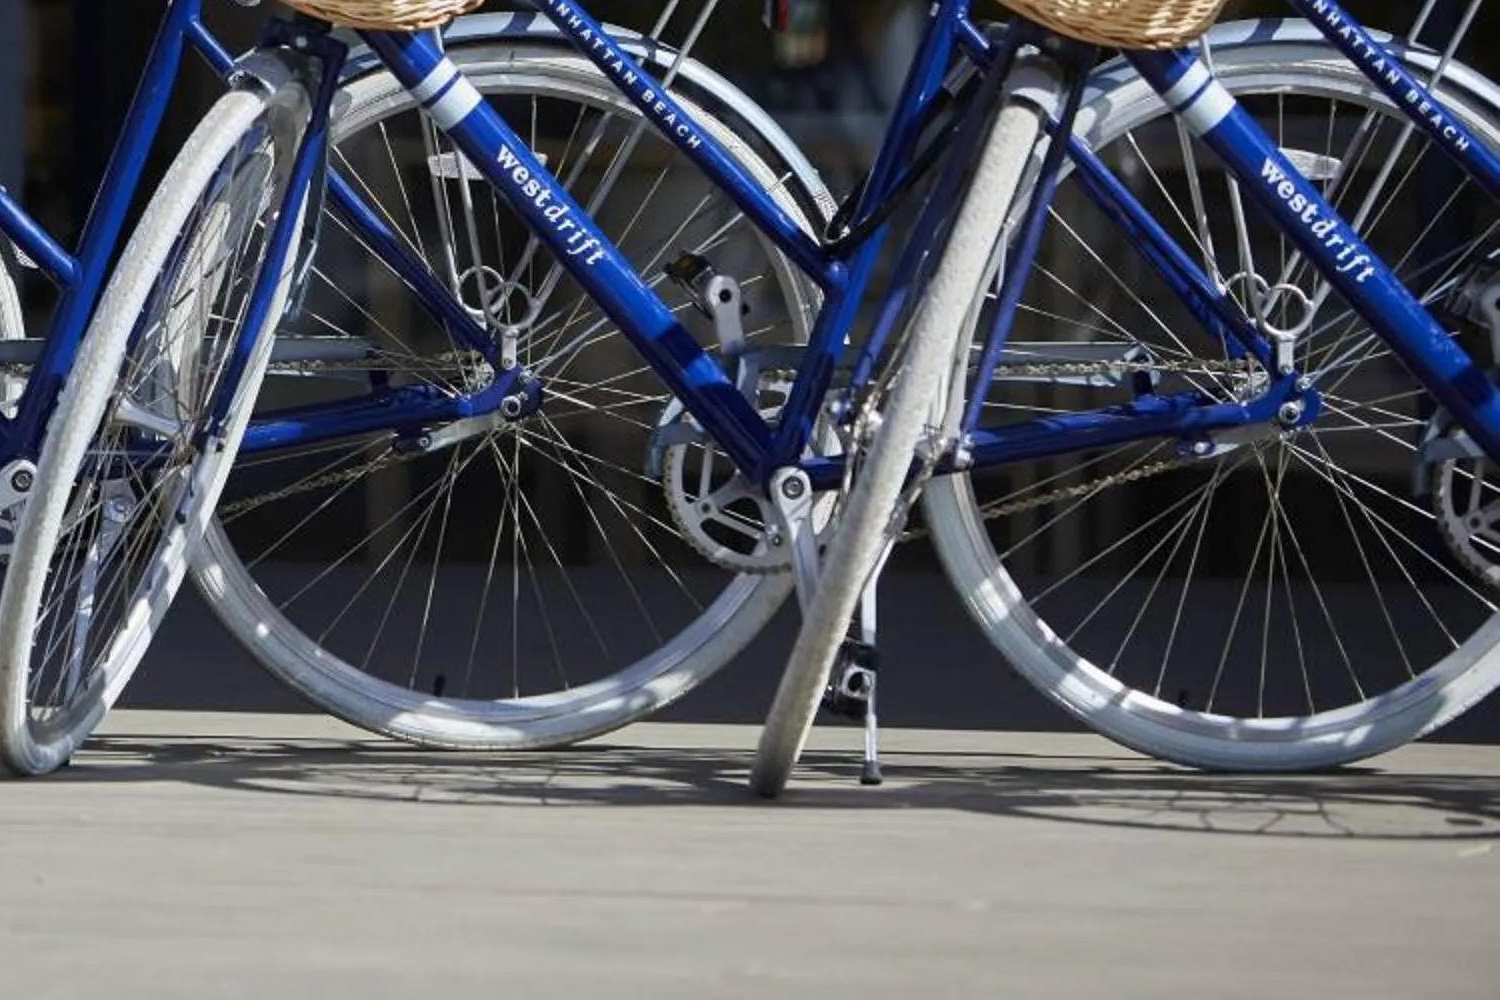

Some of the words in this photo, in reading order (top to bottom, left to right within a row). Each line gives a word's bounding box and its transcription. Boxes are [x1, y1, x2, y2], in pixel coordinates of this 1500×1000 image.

[641, 90, 701, 150] BEACH
[1406, 89, 1471, 152] BEACH
[496, 143, 607, 266] westdrift
[1260, 158, 1376, 283] westdrift
